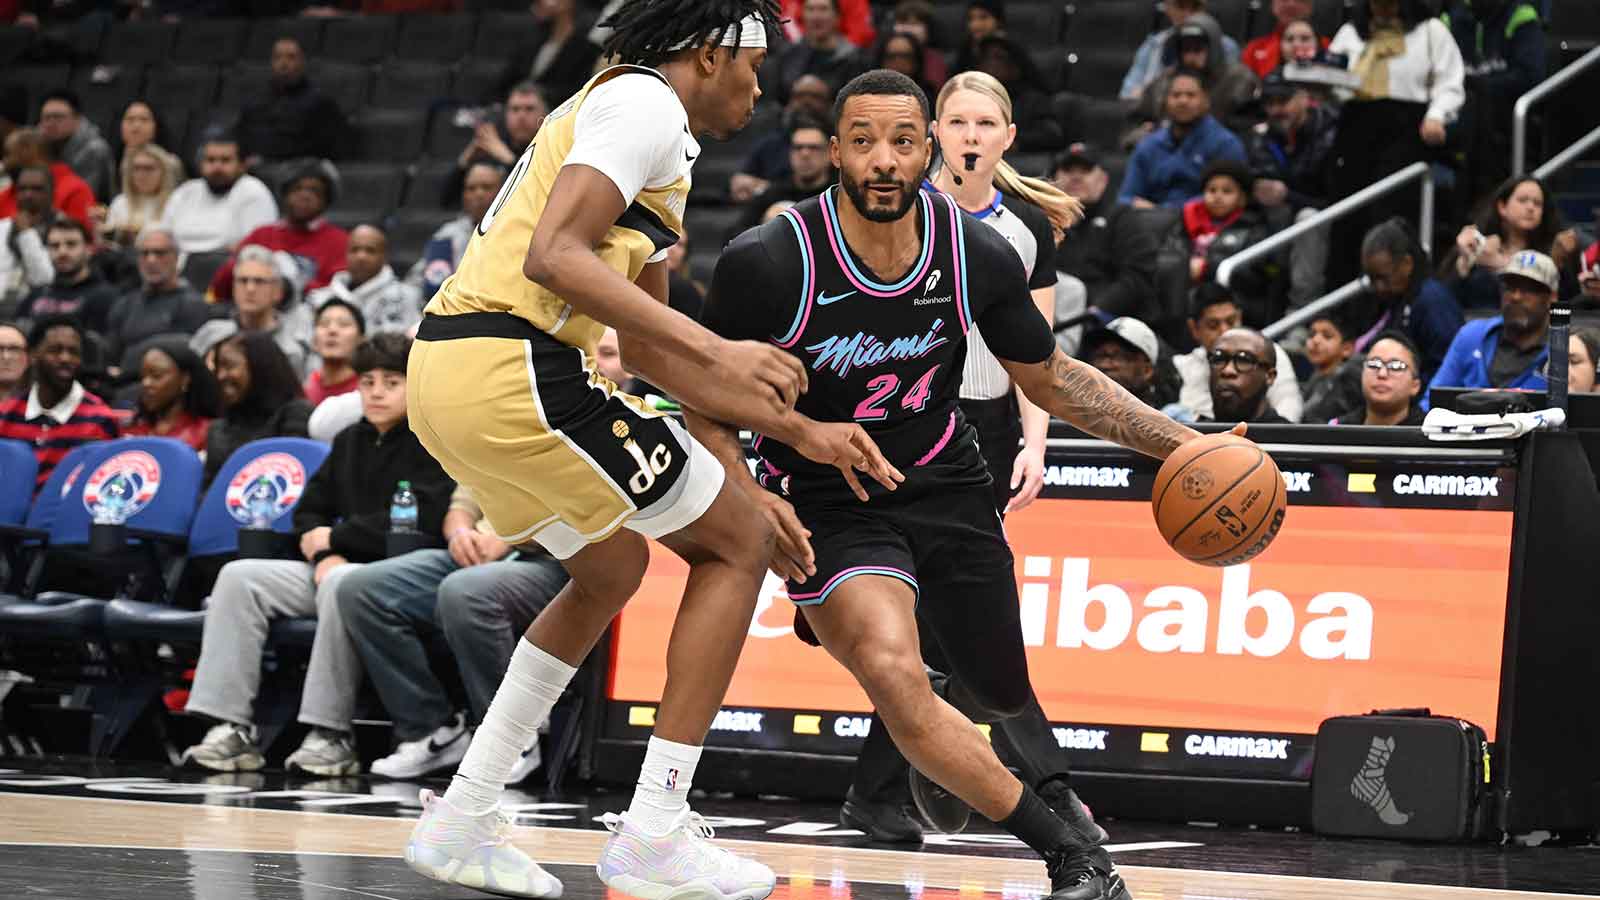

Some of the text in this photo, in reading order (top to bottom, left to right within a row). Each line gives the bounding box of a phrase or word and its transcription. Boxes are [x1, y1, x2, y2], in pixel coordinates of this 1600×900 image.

[913, 296, 951, 306] Robinhood
[804, 318, 950, 379] Miami
[853, 364, 942, 422] 24
[1019, 555, 1373, 661] ibaba
